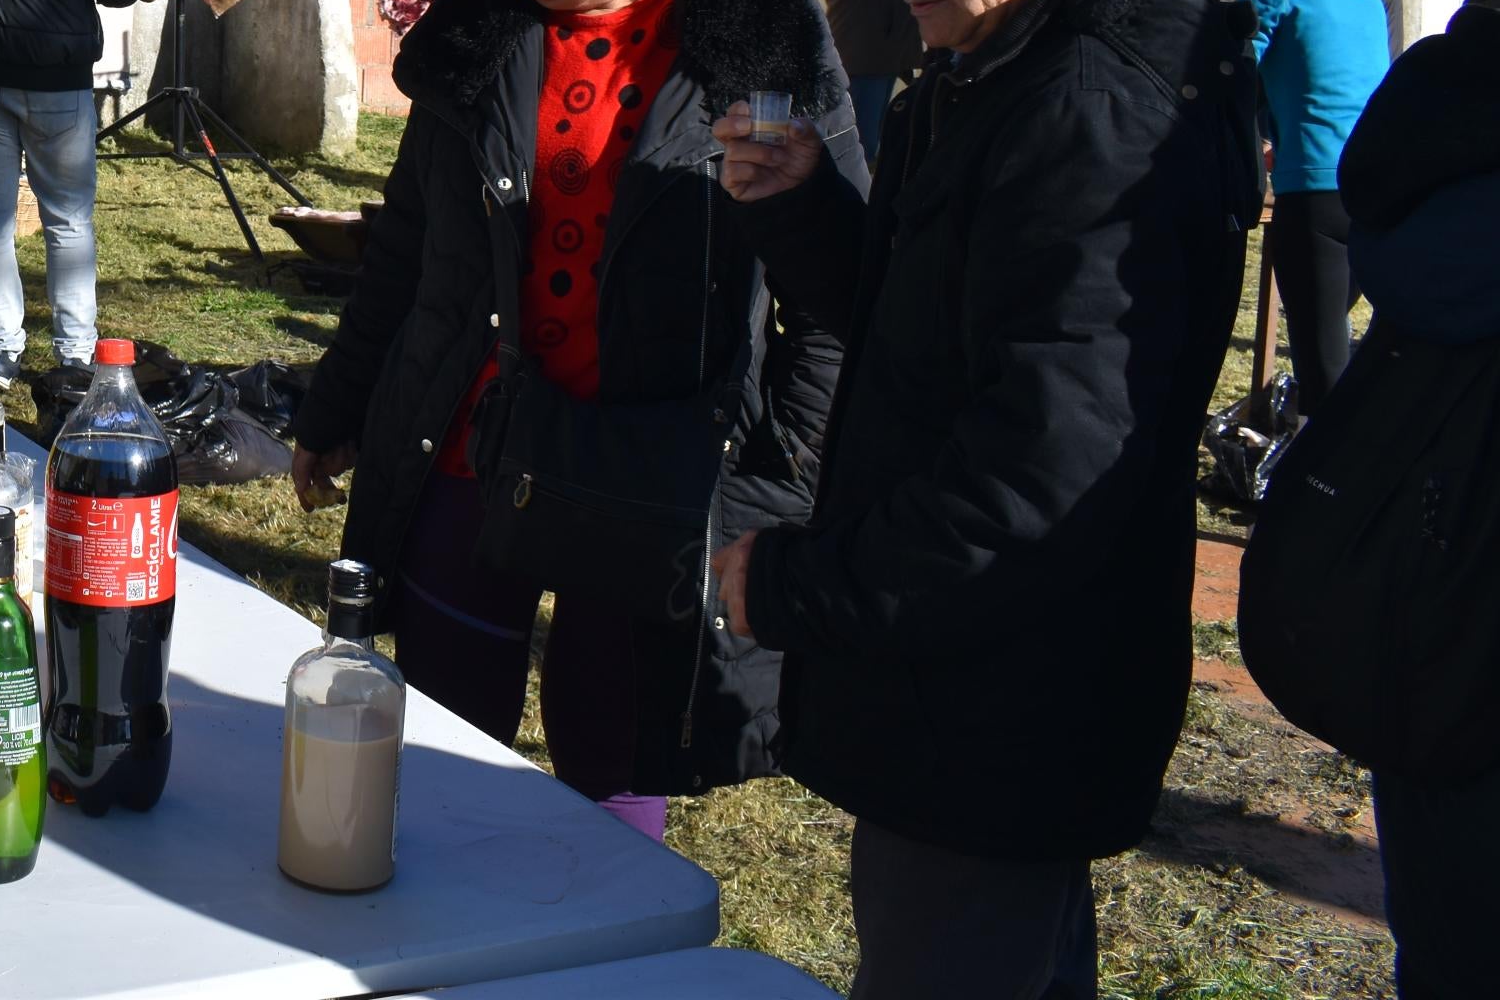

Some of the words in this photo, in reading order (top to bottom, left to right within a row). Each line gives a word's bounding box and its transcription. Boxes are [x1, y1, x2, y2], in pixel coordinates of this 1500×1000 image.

[92, 500, 97, 510] 2
[133, 546, 141, 554] 8
[147, 497, 161, 599] RECÍCLAME
